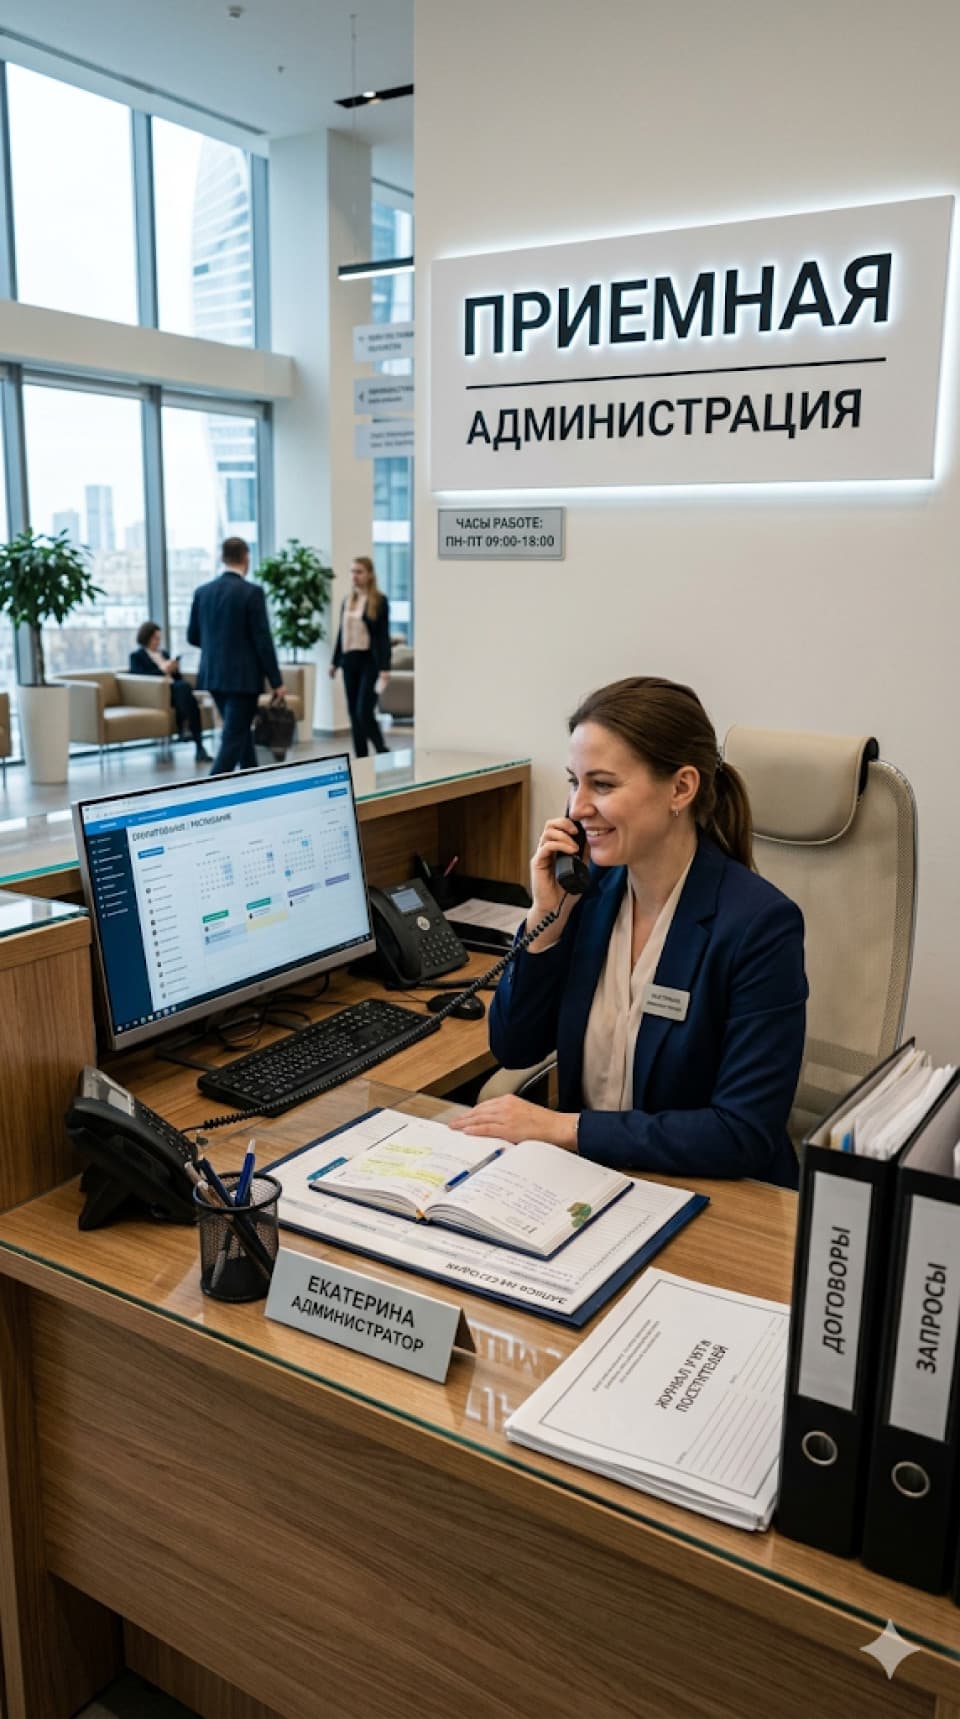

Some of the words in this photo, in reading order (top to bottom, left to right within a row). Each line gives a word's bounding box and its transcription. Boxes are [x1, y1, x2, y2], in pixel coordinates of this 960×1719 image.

[464, 253, 892, 357] ПРИЕМНАЯ
[466, 388, 862, 451] АДМИНИСТРАЦИЯ
[446, 536, 482, 547] ПН-ПТ
[485, 535, 555, 547] 09:00-18:00
[456, 517, 491, 529] ЧАСЫ
[308, 1275, 415, 1329] ЕКАТЕРИНА
[823, 1226, 851, 1354] ДОГОВОРЫ
[916, 1263, 947, 1374] ЗАПРОСЫ
[291, 1295, 424, 1352] АДМИНИСТРАТОР
